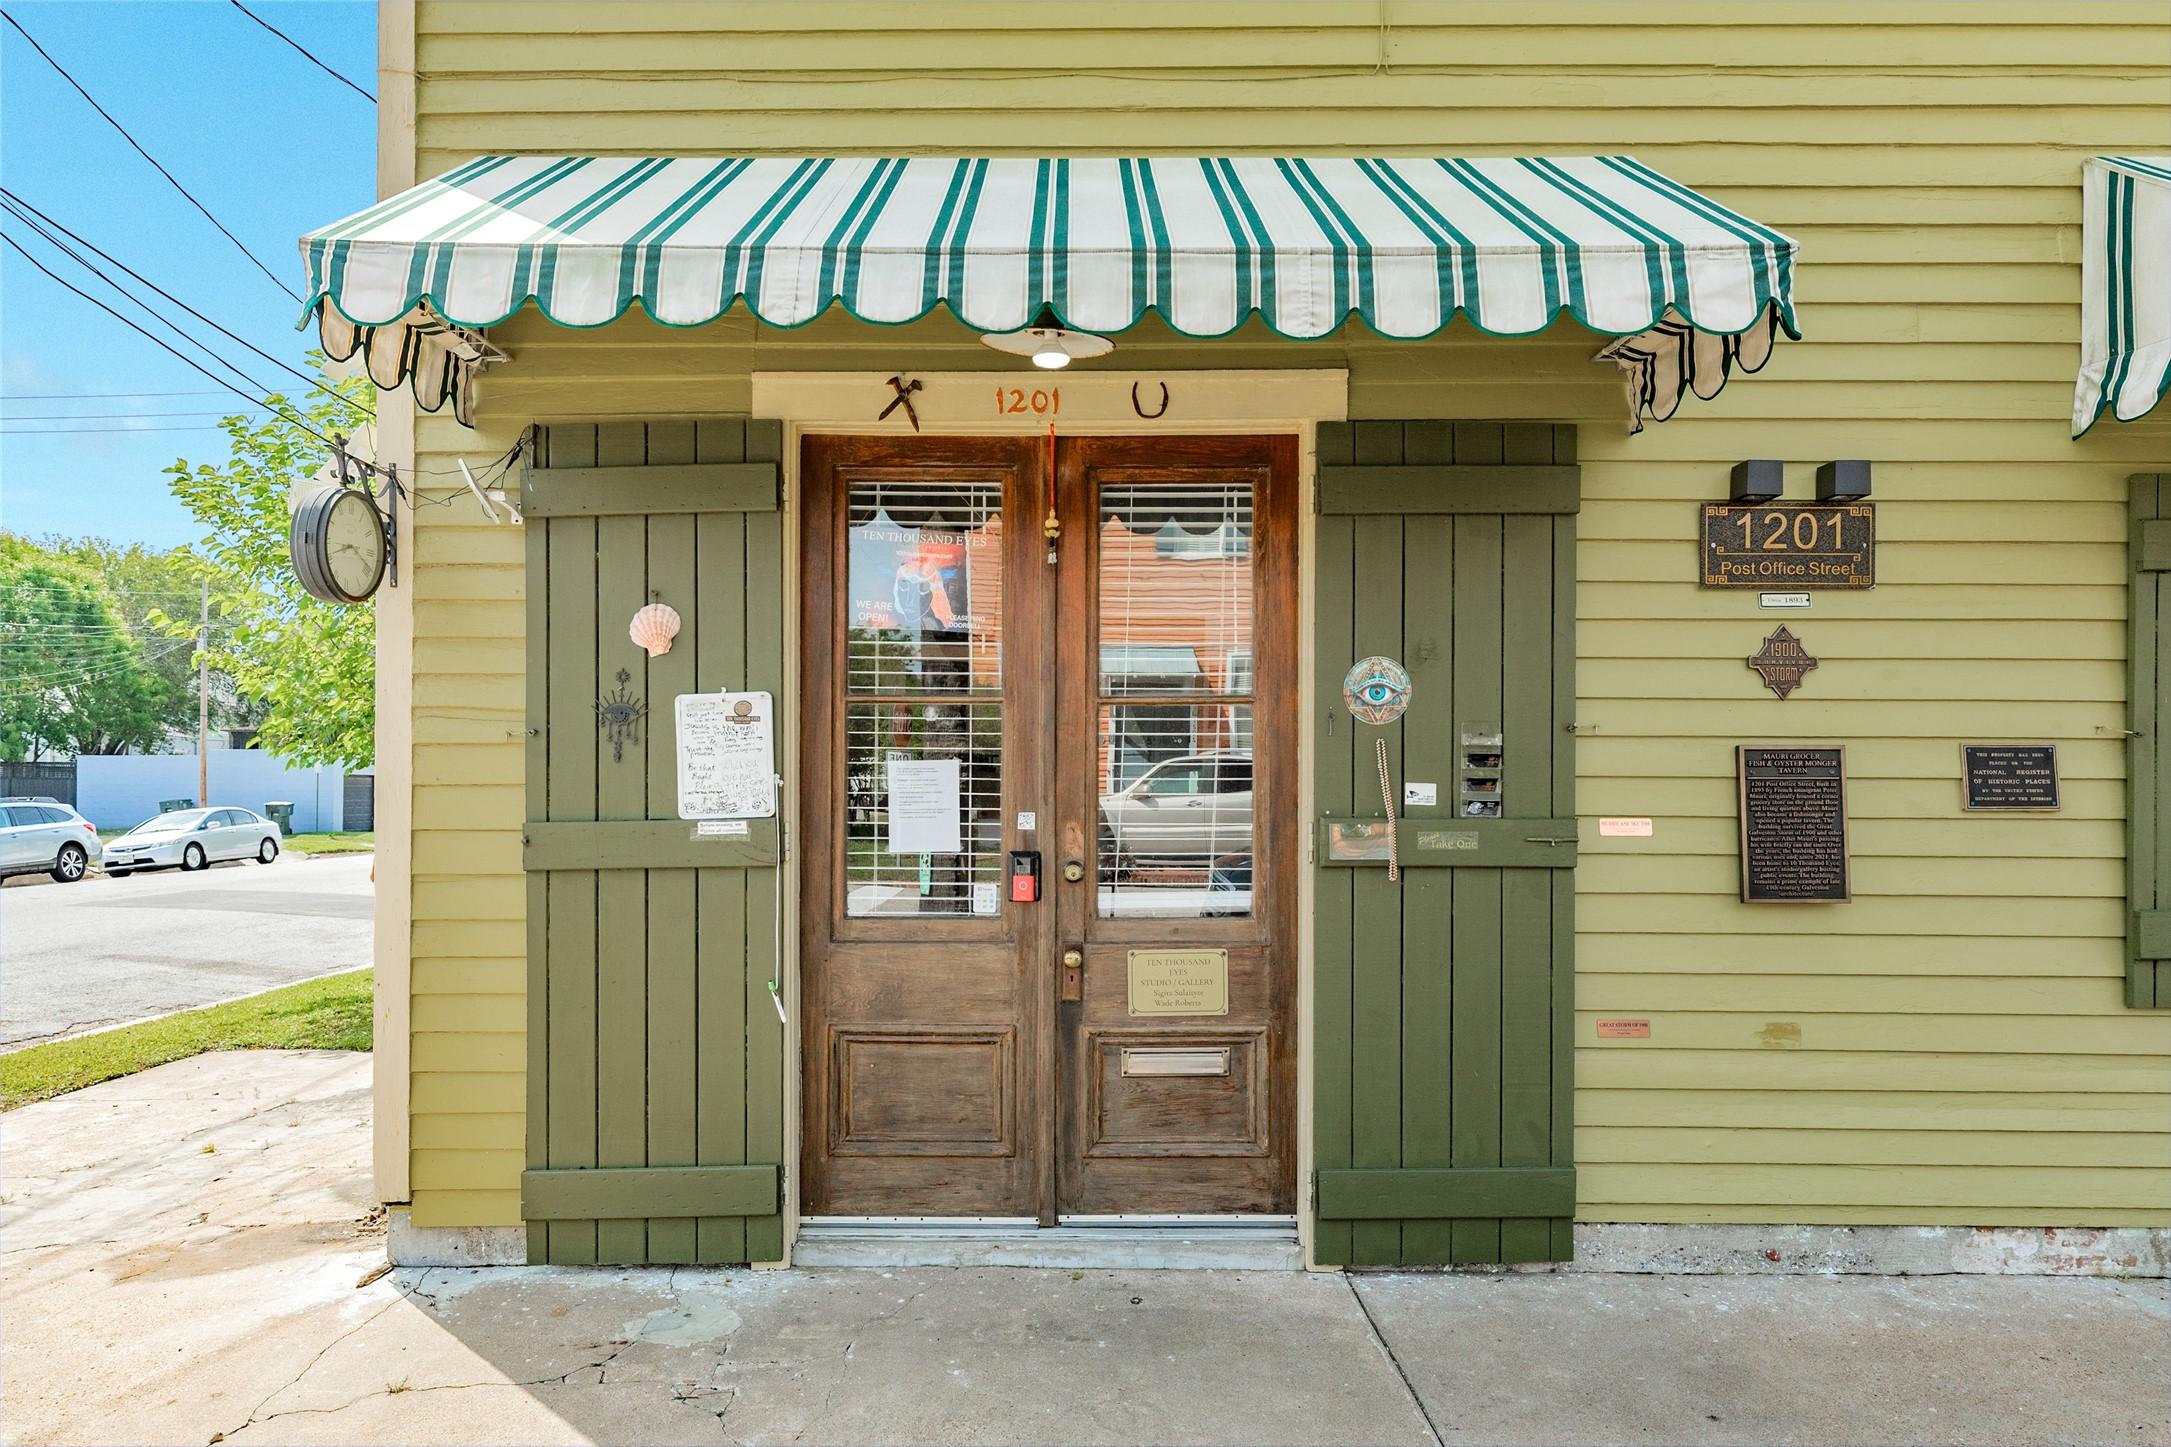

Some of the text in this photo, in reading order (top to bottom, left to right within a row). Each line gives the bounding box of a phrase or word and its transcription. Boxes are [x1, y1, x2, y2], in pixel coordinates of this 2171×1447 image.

[996, 386, 1059, 415] 1201
[862, 530, 987, 546] TEN THOUSAND EYES
[1736, 512, 1843, 550] 1201
[1721, 562, 1856, 575] Post Office Street
[856, 600, 892, 611] WE ARE
[858, 612, 888, 622] OPEN!
[1771, 643, 1797, 657] 1900
[1770, 667, 1798, 682] STORM
[1431, 840, 1478, 849] Take One
